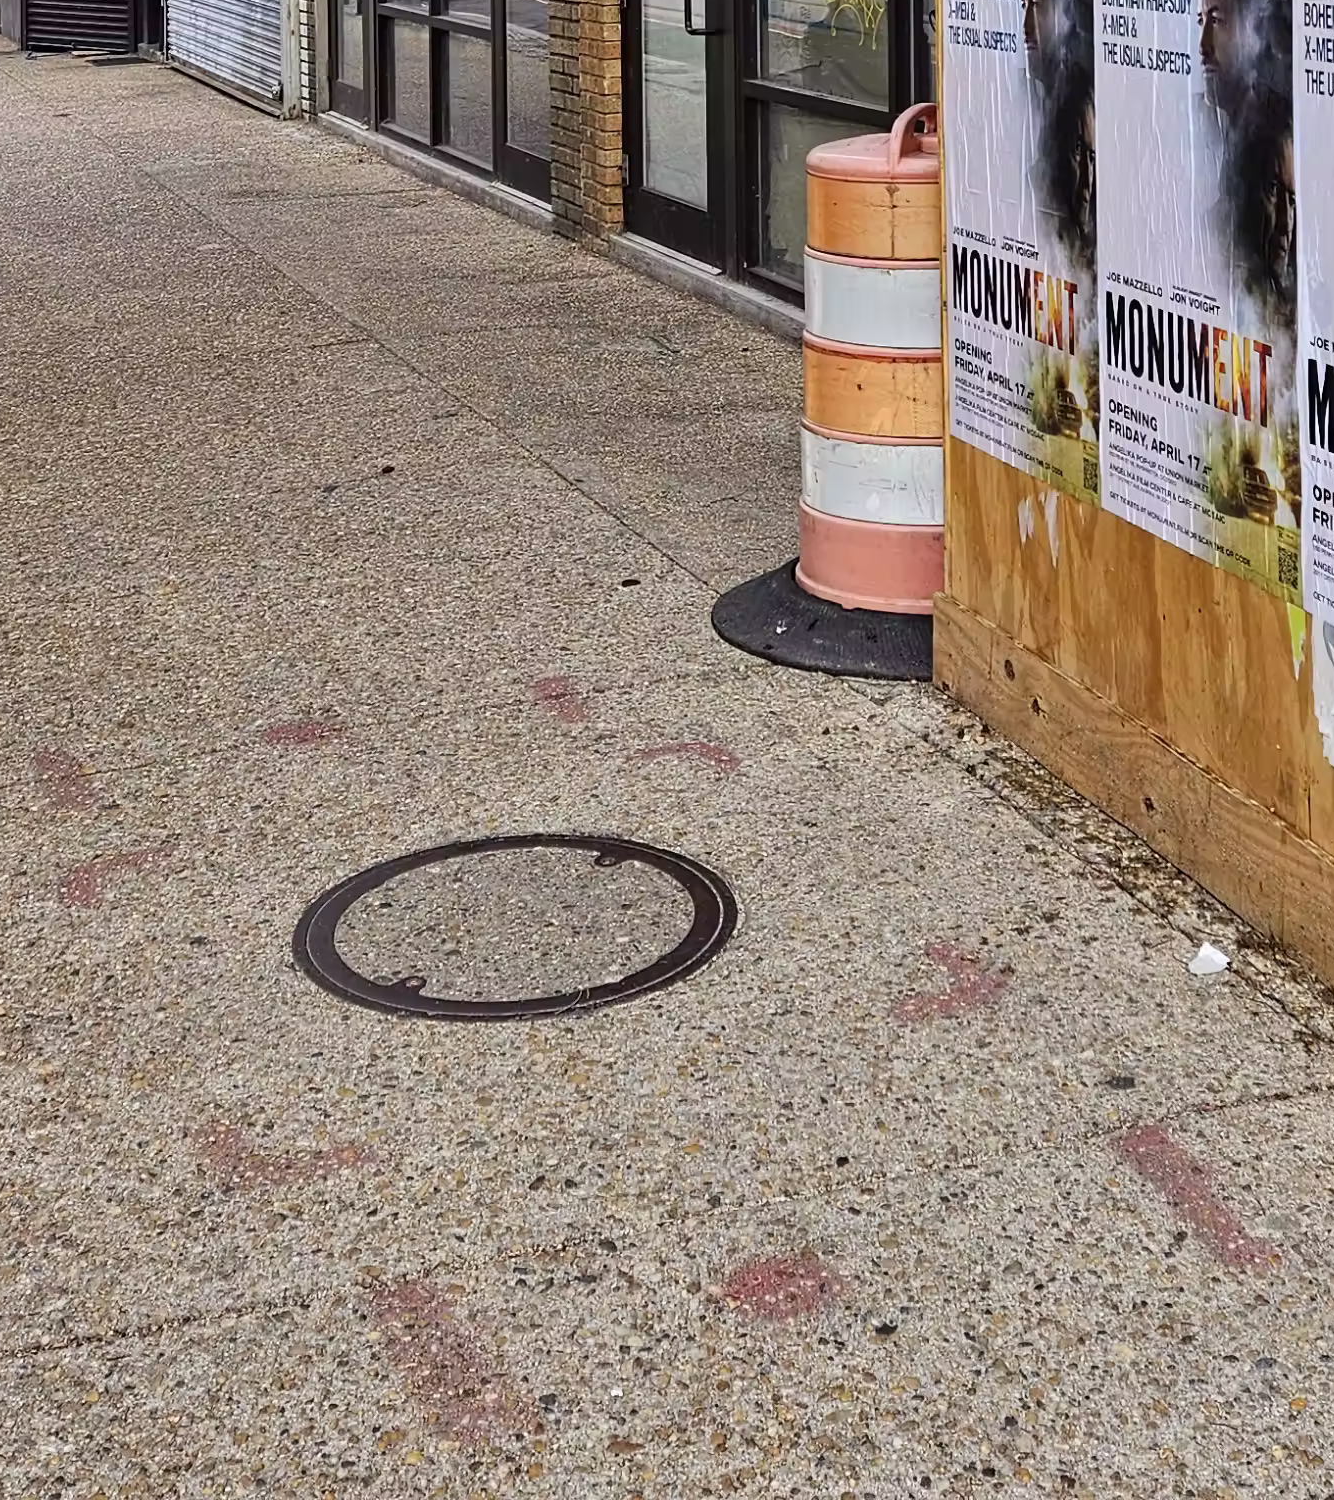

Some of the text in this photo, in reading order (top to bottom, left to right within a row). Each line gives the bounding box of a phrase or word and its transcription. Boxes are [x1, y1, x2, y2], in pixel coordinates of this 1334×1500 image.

[951, 243, 1079, 358] MONUMENT
[1105, 291, 1273, 431] MONUMENT
[1108, 397, 1158, 433] OPENING
